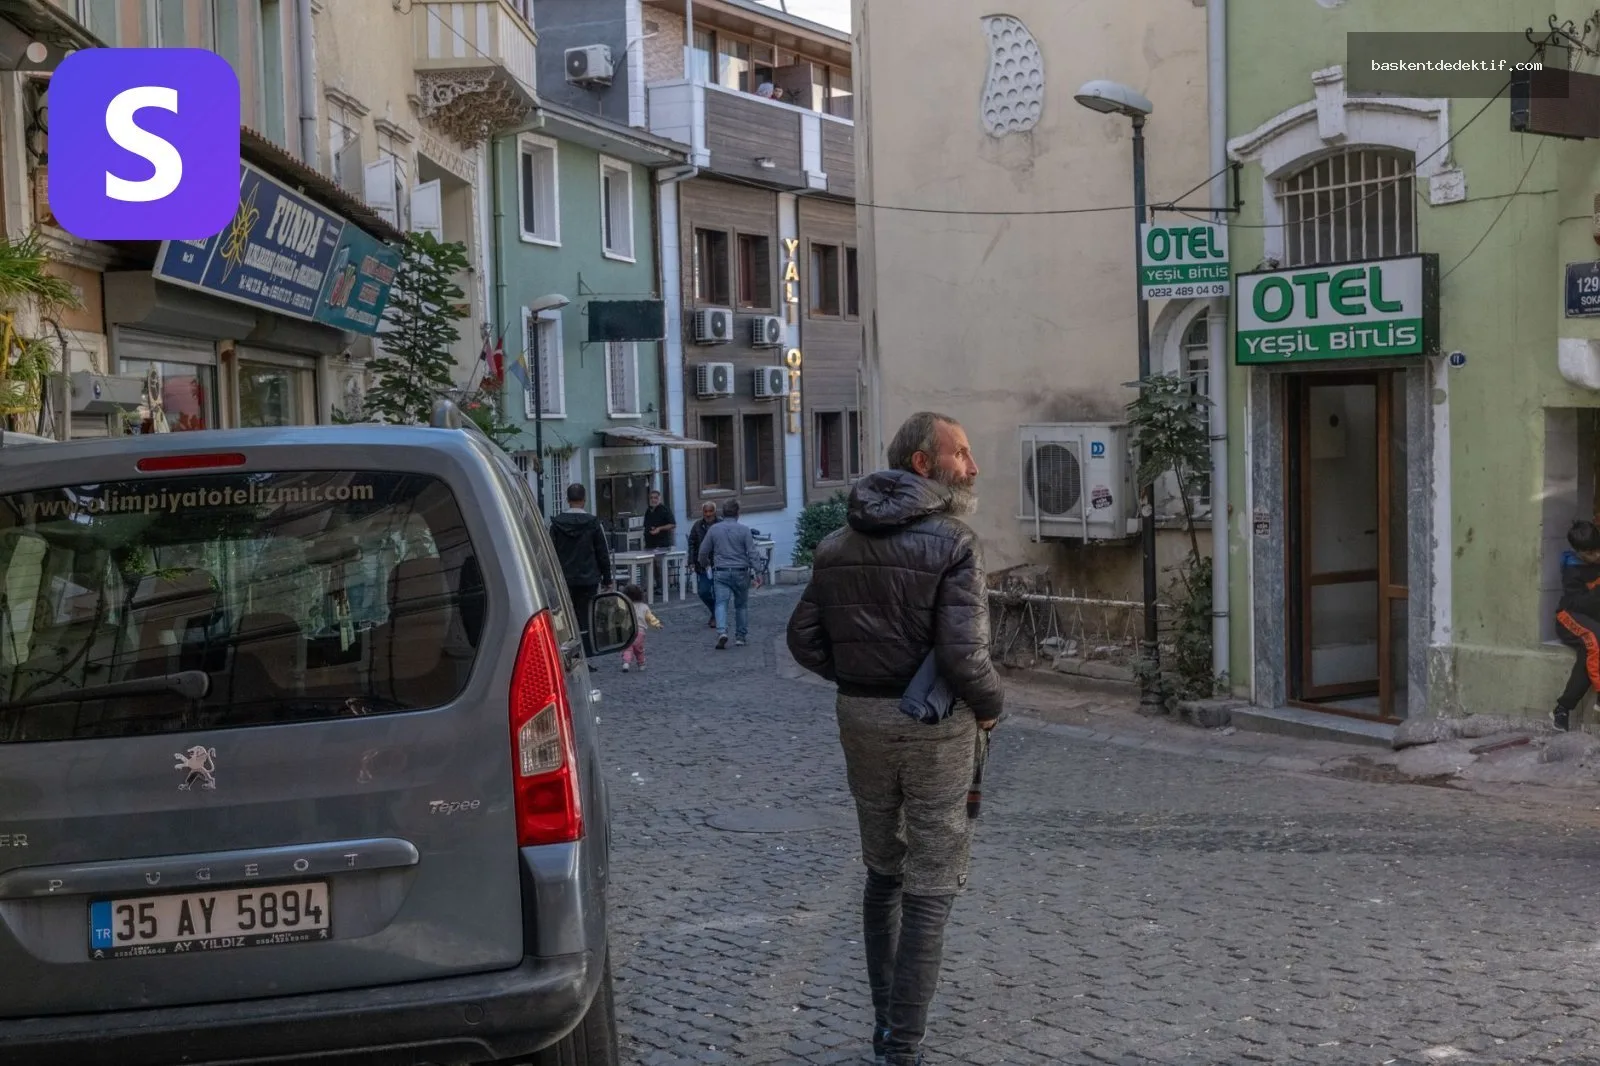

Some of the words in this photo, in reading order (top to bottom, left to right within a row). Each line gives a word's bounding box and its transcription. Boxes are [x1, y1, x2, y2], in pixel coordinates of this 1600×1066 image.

[266, 194, 325, 259] FUNDA
[1146, 226, 1224, 261] OTEL
[784, 237, 799, 324] YALI
[1147, 268, 1184, 282] YEŞİL
[1189, 266, 1228, 279] BİTLİS
[1148, 286, 1172, 298] 0232
[1175, 285, 1193, 297] 489
[1196, 285, 1209, 296] 04
[1212, 284, 1224, 295] 09
[1577, 276, 1600, 293] 129
[1252, 265, 1403, 323] OTEL
[1244, 330, 1319, 358] YEŞİL
[1329, 323, 1417, 350] BİTLİS
[786, 348, 801, 434] OTEL
[19, 481, 374, 517] www.olimpiyatotelizmir.com
[429, 799, 481, 816] Tepee
[116, 902, 158, 942] 35
[177, 897, 216, 936] AY
[237, 888, 323, 931] 5894
[95, 928, 111, 939] TR
[173, 941, 192, 953] AY
[199, 936, 246, 950] YILDIZ
